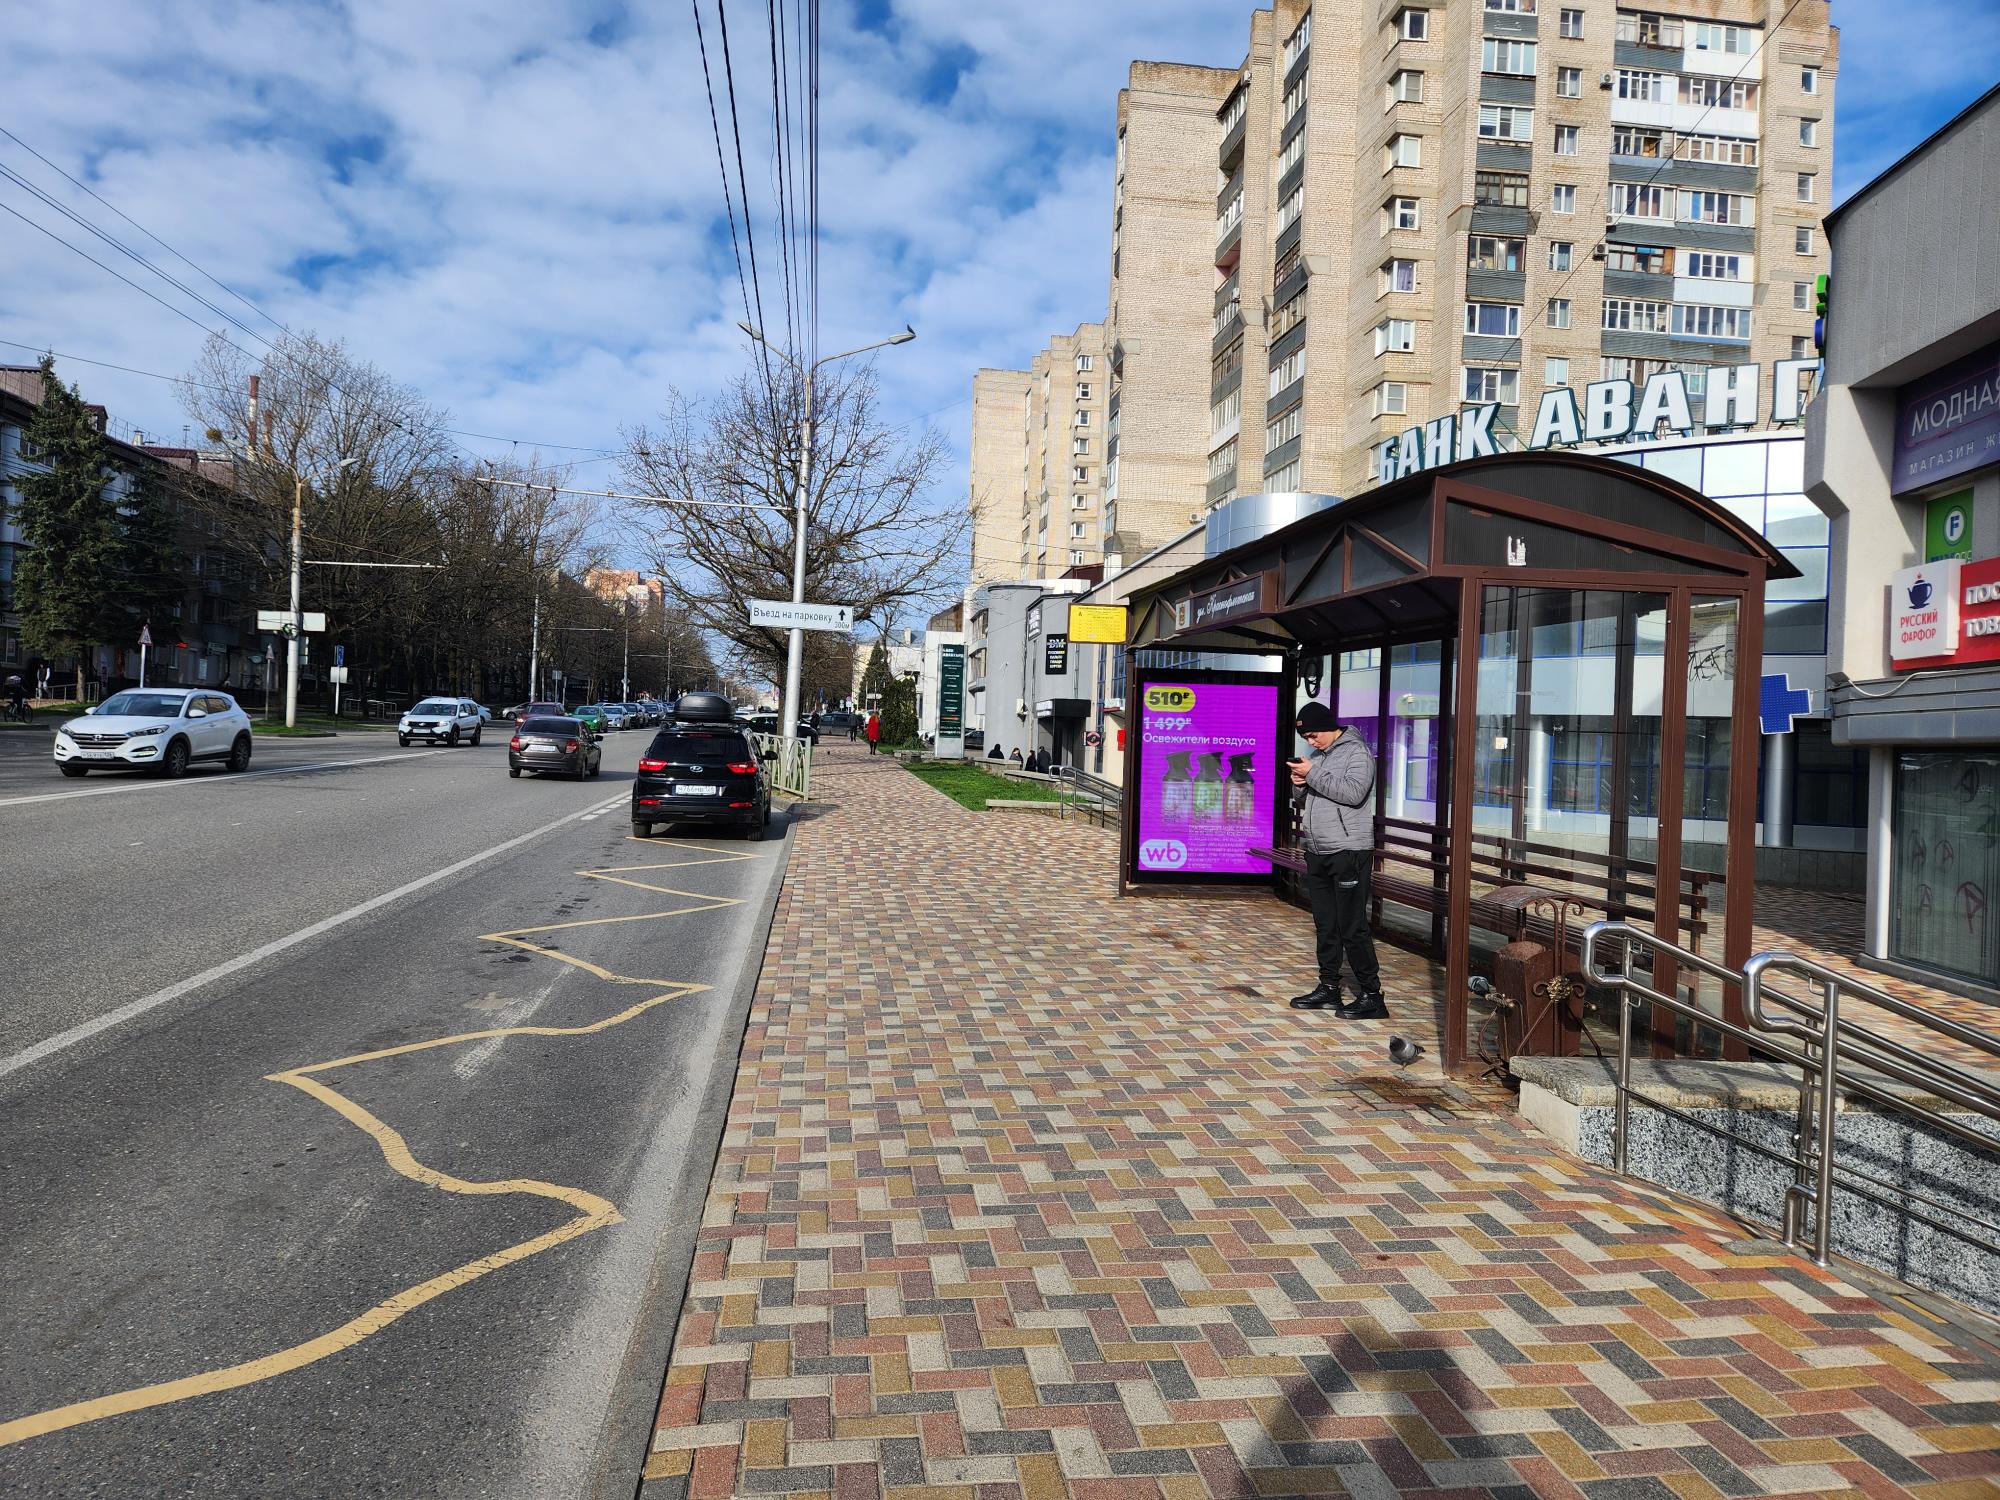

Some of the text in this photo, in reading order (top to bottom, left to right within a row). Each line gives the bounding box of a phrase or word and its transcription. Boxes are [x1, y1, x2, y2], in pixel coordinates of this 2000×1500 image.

[1379, 402, 1501, 486] БАНК
[1908, 441, 1975, 476] МАГАЗИН
[753, 607, 780, 618] Въезд
[794, 612, 833, 624] парковку
[1196, 608, 1206, 624] ул.
[1900, 609, 1938, 628] РУССКИЙ
[1901, 628, 1937, 643] ФАРФОР
[1964, 615, 2000, 638] ТОВ
[1142, 732, 1256, 747] Освежители воздуха
[1146, 842, 1181, 862] wb
